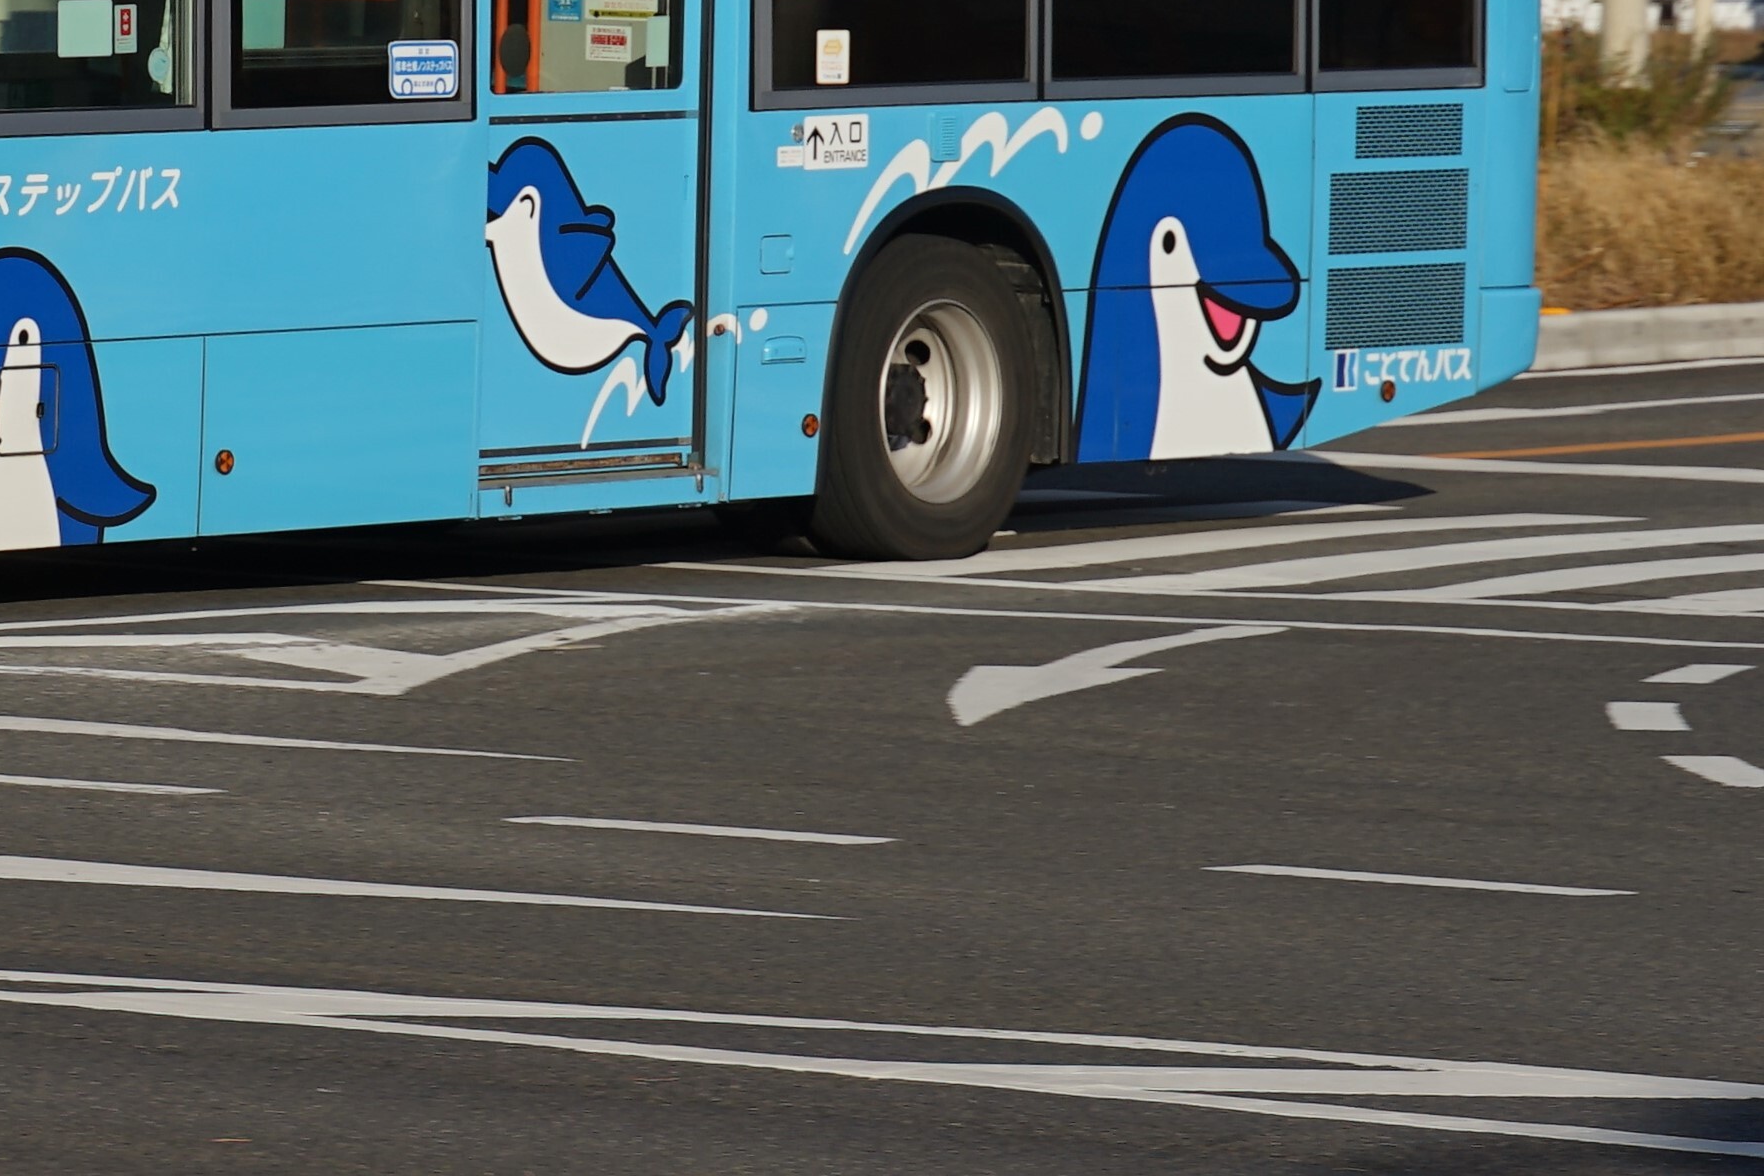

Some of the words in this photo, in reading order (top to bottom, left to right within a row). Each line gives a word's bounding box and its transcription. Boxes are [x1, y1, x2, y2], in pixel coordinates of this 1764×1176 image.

[830, 121, 862, 145] 入口
[824, 149, 867, 164] ENTRANCE
[1364, 348, 1472, 385] ことでんバス
